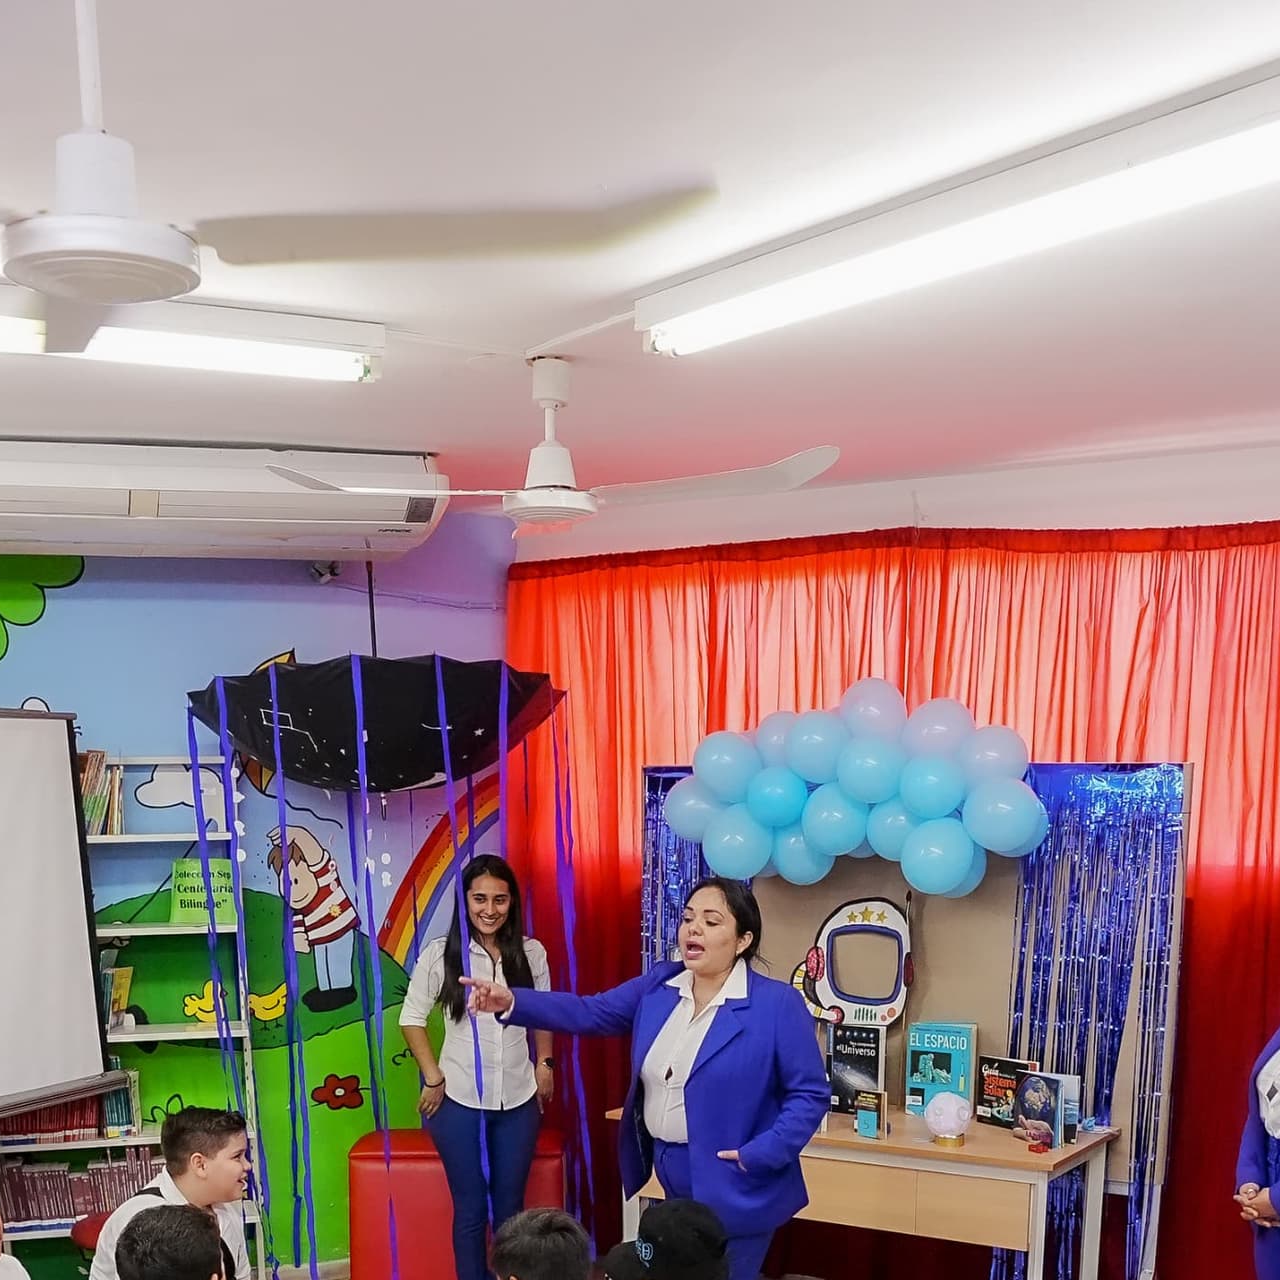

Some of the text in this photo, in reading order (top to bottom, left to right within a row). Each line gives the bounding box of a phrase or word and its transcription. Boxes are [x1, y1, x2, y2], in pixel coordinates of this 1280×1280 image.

[910, 1032, 967, 1050] EL ESPACIO
[842, 1044, 876, 1057] Universo
[983, 1073, 1016, 1089] Sistema
